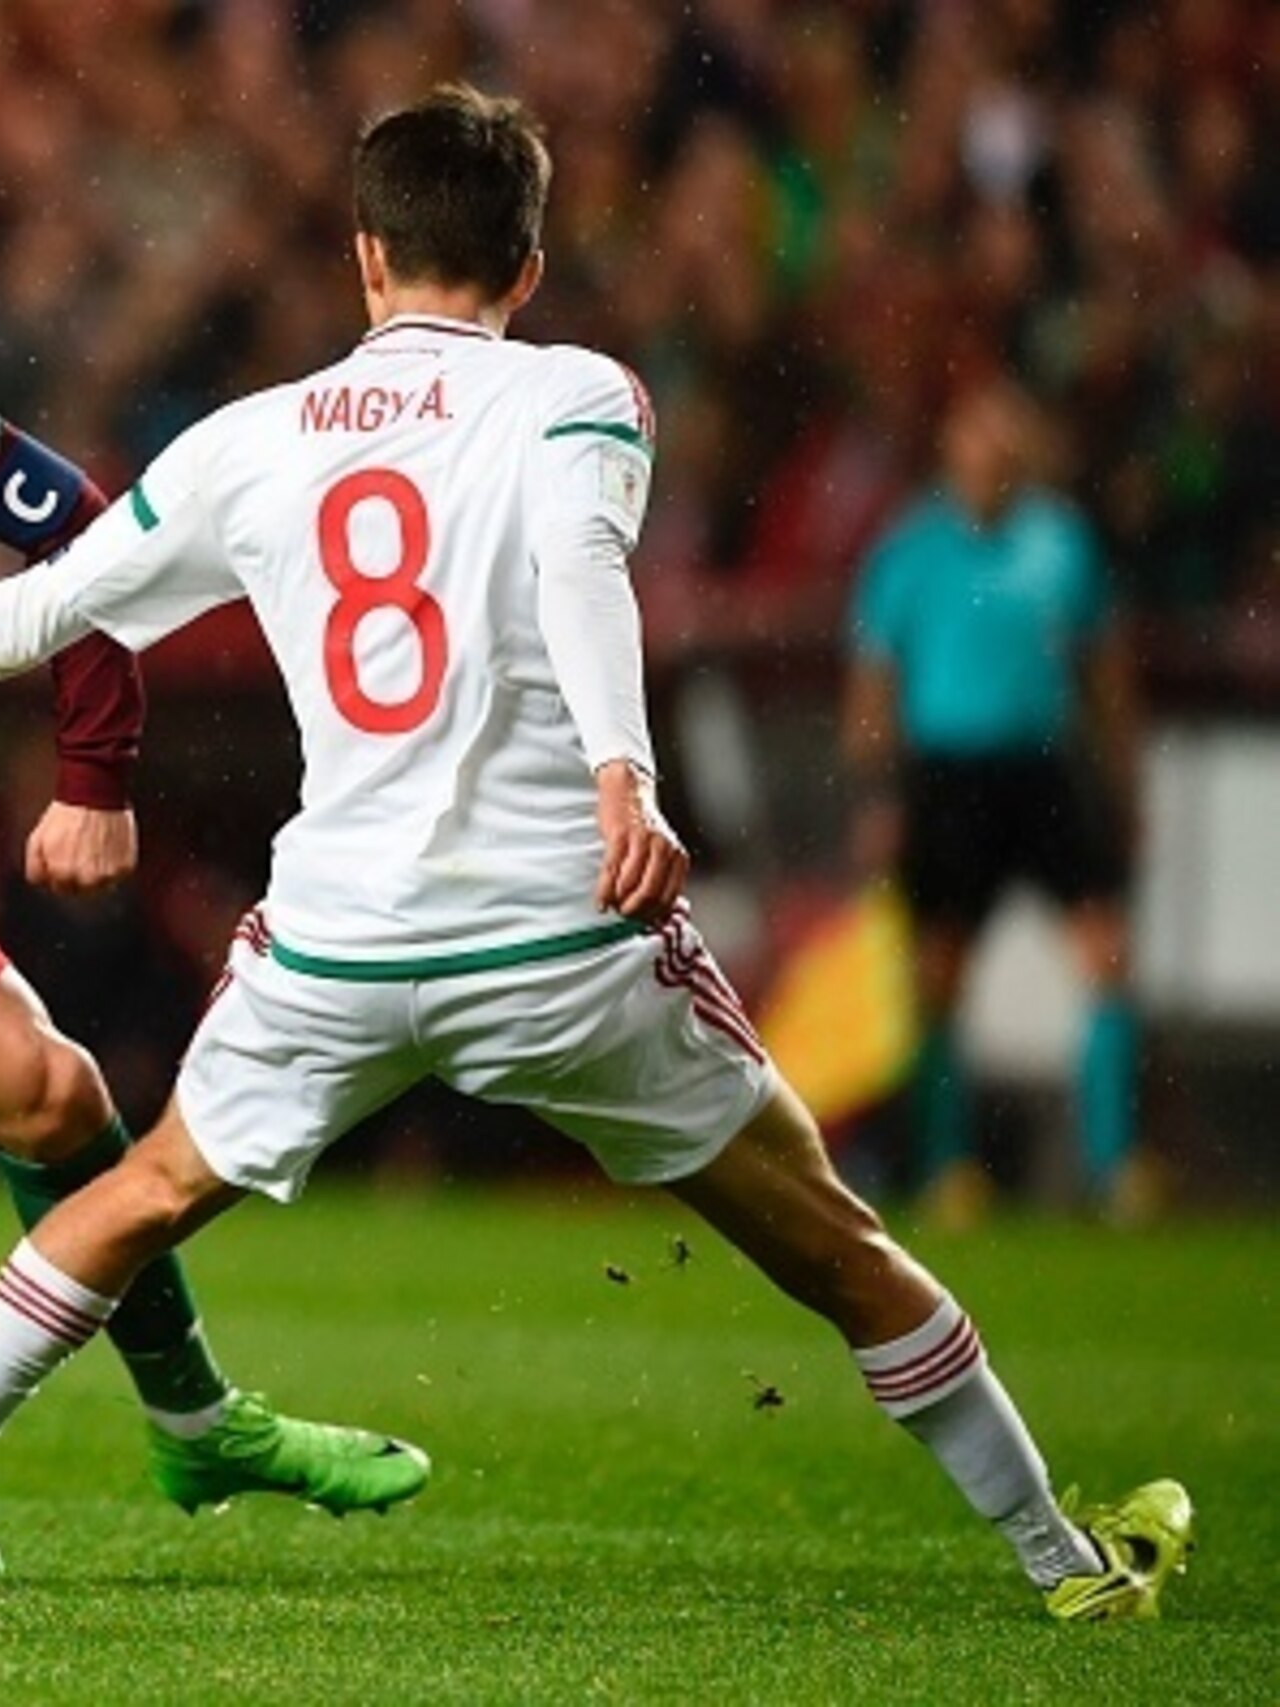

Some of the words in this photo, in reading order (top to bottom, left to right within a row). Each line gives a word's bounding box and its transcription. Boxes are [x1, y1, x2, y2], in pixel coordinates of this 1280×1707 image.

[301, 386, 417, 434] NAGY
[3, 468, 59, 523] C
[317, 467, 449, 736] 8
